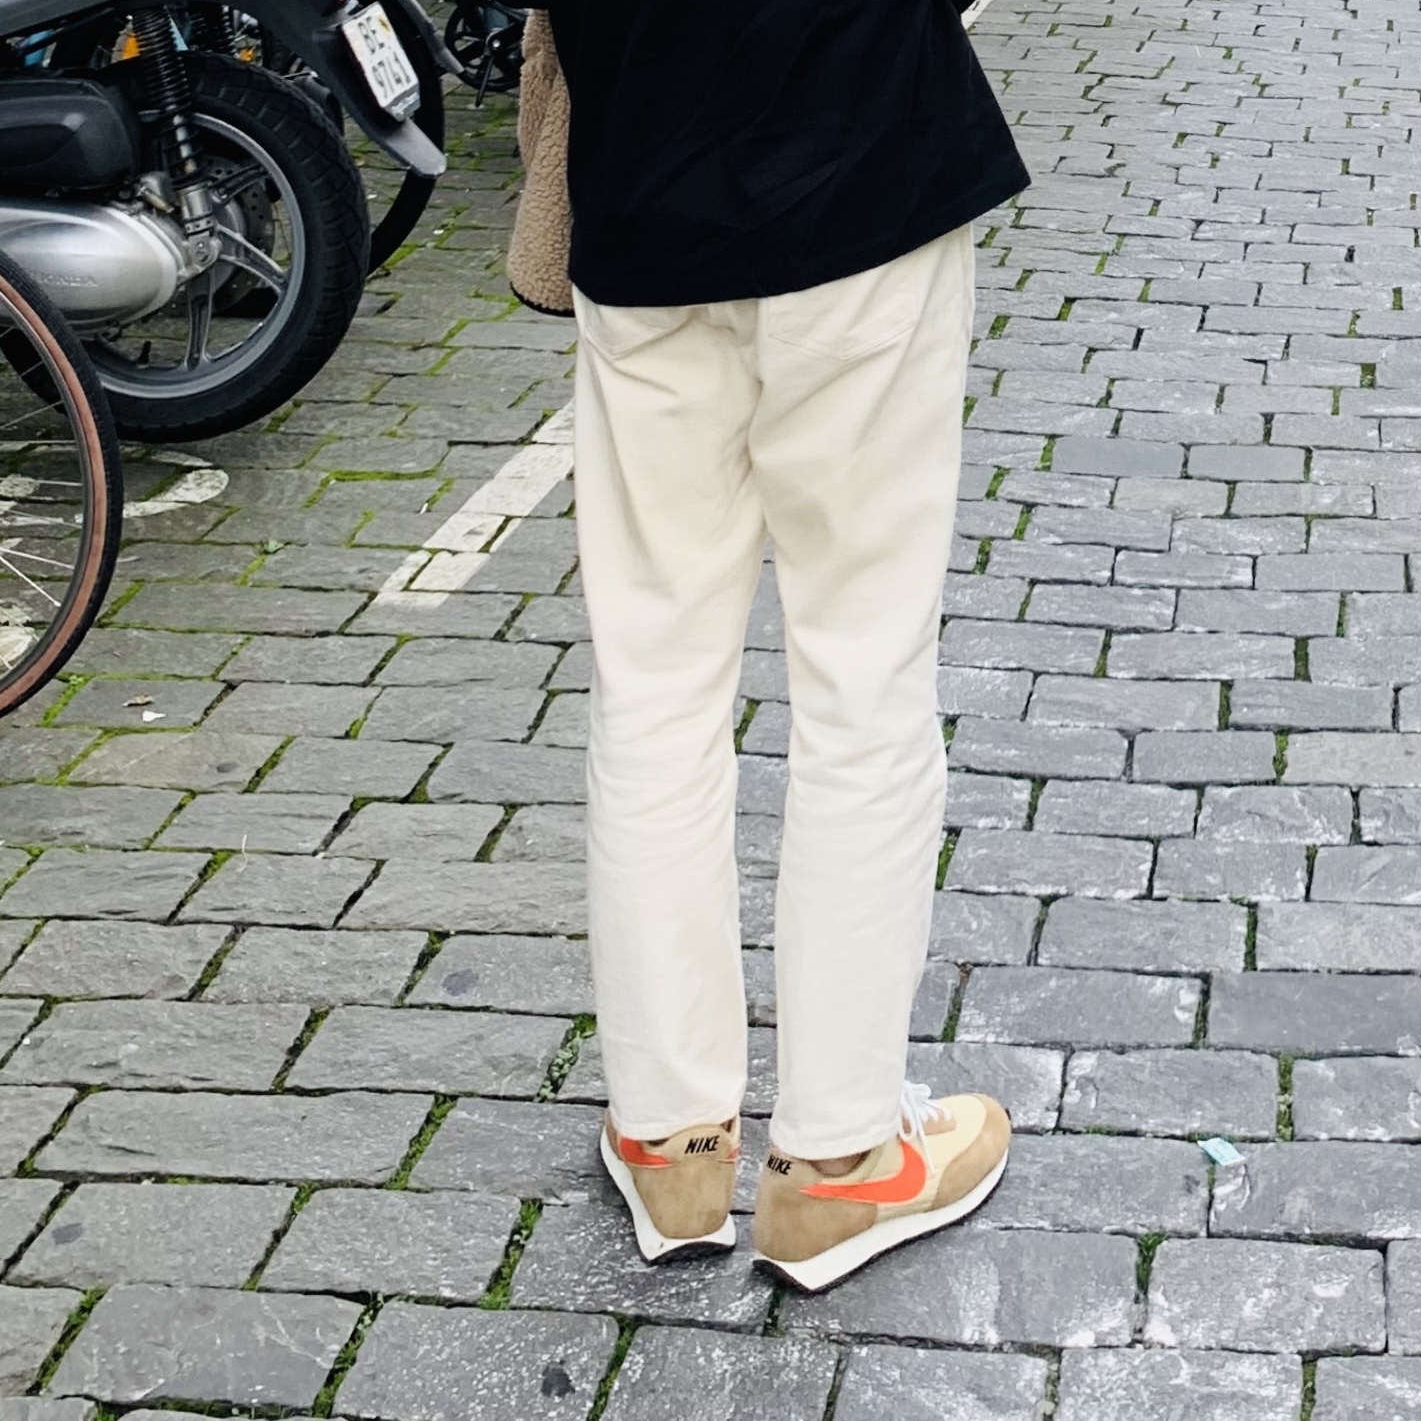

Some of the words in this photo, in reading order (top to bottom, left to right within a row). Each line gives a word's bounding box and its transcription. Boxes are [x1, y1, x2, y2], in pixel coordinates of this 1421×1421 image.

[358, 15, 386, 55] BE
[684, 1134, 720, 1154] NIKE
[766, 1153, 792, 1176] NIKE
